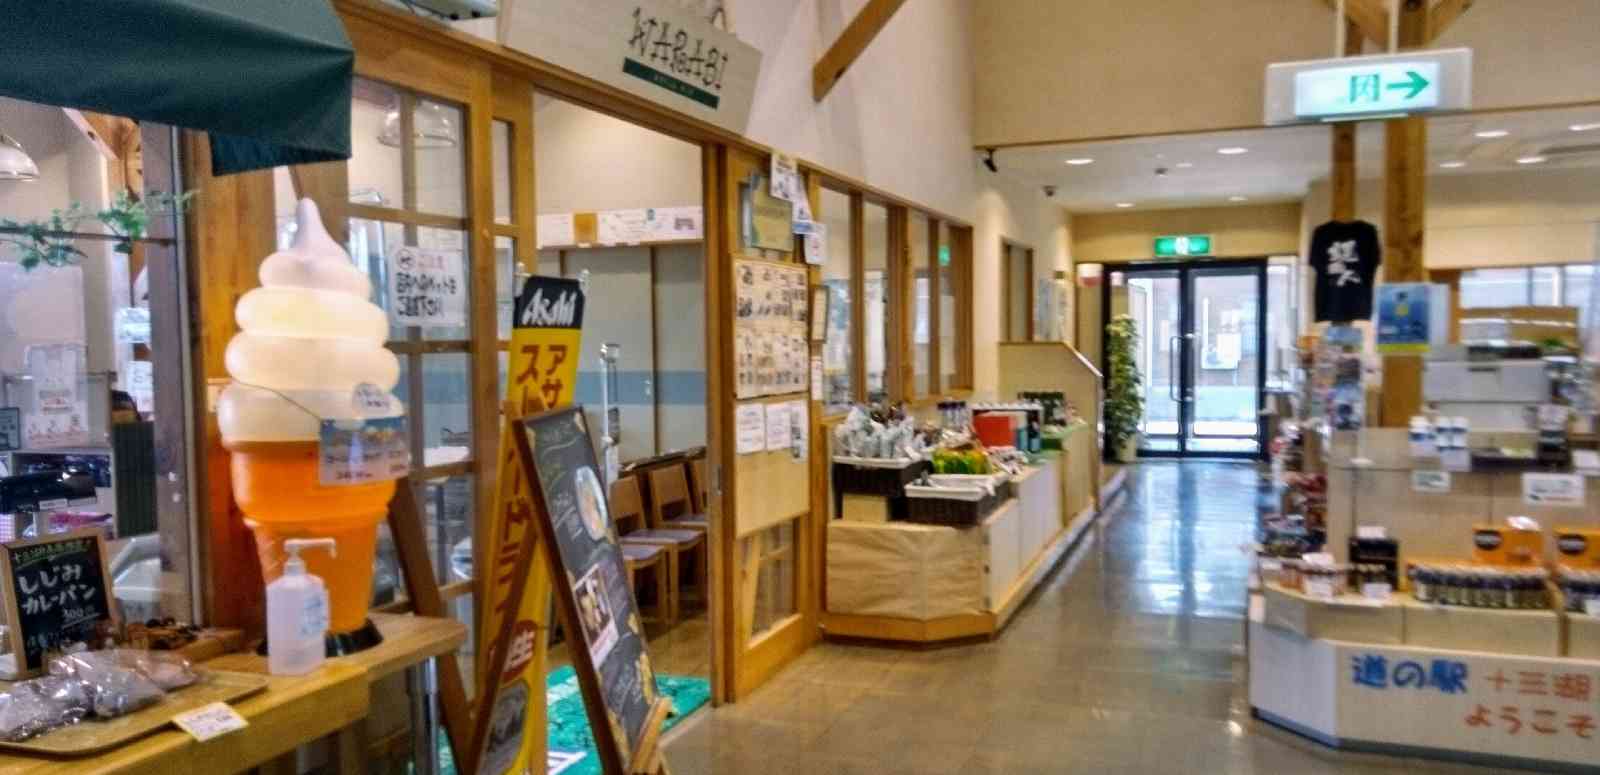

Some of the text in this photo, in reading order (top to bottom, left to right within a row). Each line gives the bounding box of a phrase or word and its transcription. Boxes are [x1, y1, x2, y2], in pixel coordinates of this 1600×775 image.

[521, 287, 578, 327] Asahi
[18, 563, 83, 594] しじみ
[21, 583, 97, 616] カレーパン
[1351, 654, 1469, 695] 道の駅
[1464, 703, 1598, 739] ようこそ
